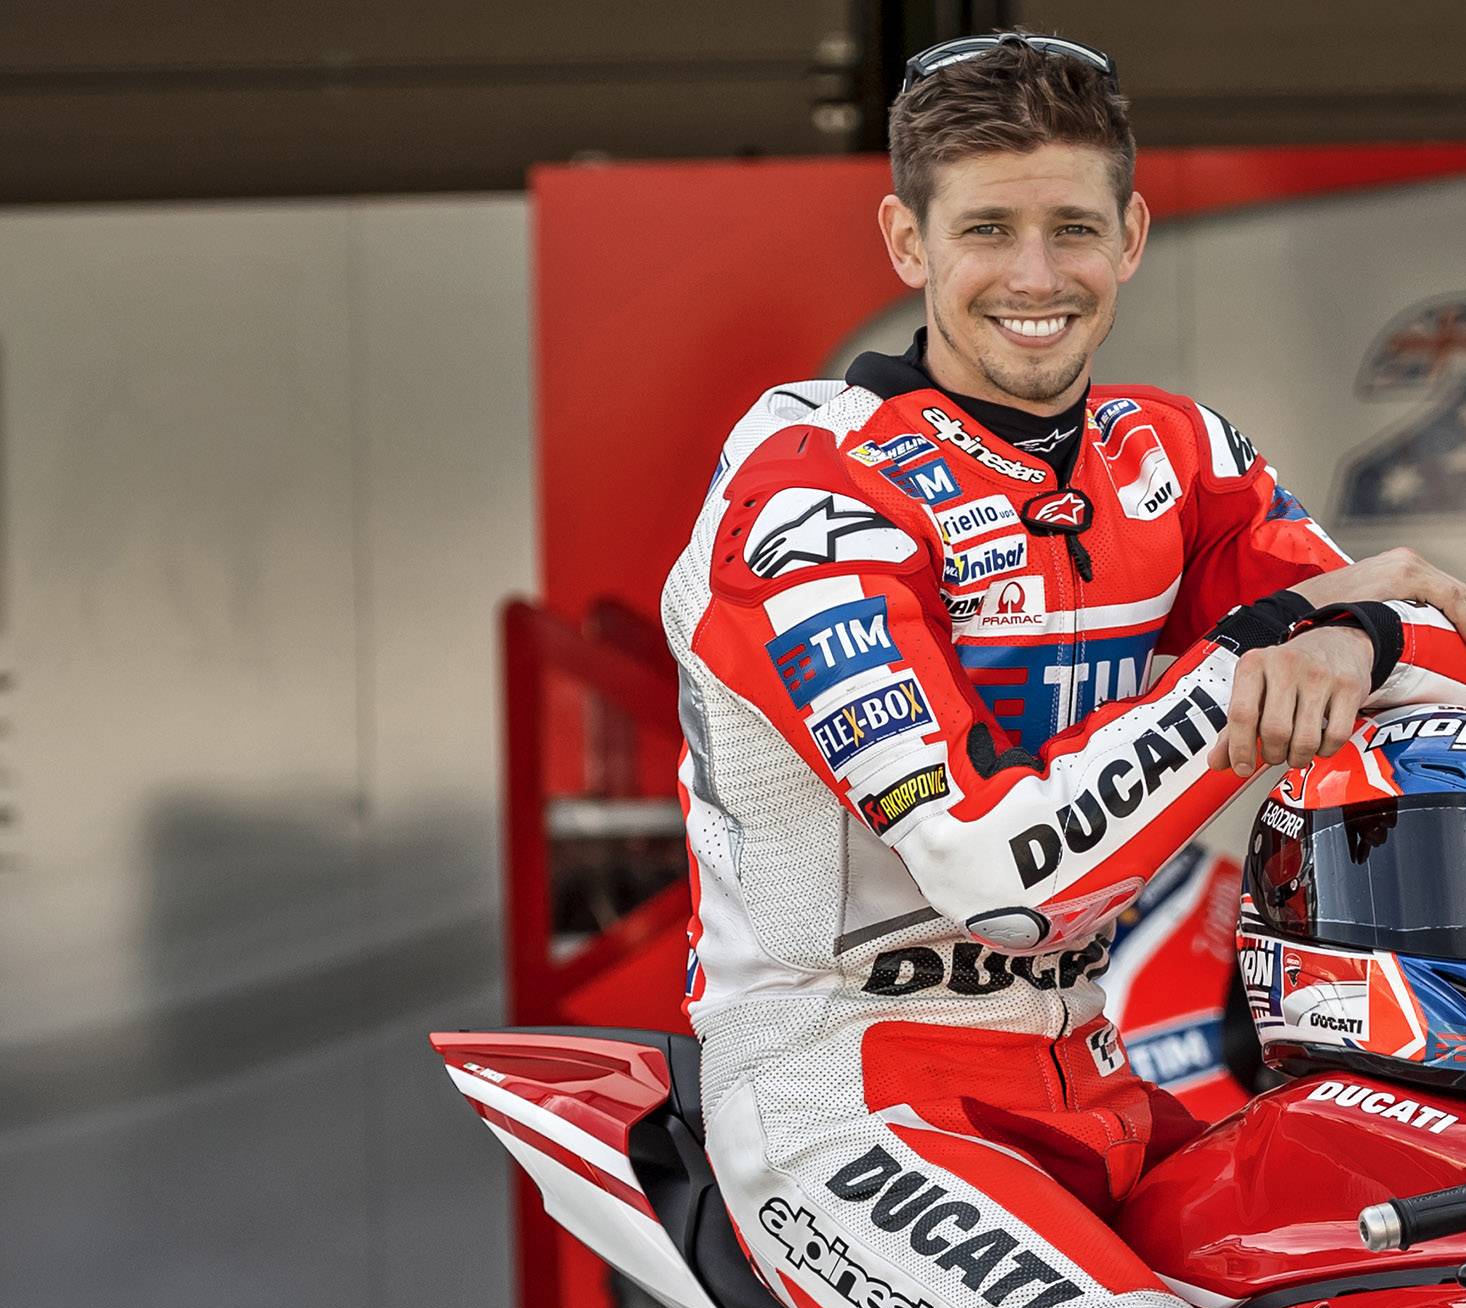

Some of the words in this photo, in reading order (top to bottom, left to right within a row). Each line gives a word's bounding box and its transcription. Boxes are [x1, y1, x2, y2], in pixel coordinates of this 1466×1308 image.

[921, 407, 1046, 484] alpinestars
[943, 506, 999, 538] riello
[957, 543, 1025, 583] Unibat
[809, 614, 892, 667] TIM
[982, 614, 1043, 626] PRAMAC
[1043, 649, 1153, 736] TIM
[815, 682, 924, 758] FLEX-BOX
[1008, 684, 1228, 890] DUCATI
[1261, 801, 1304, 840] X-802RR
[1310, 1012, 1363, 1034] DUCATI
[1308, 1080, 1460, 1136] DUCATI
